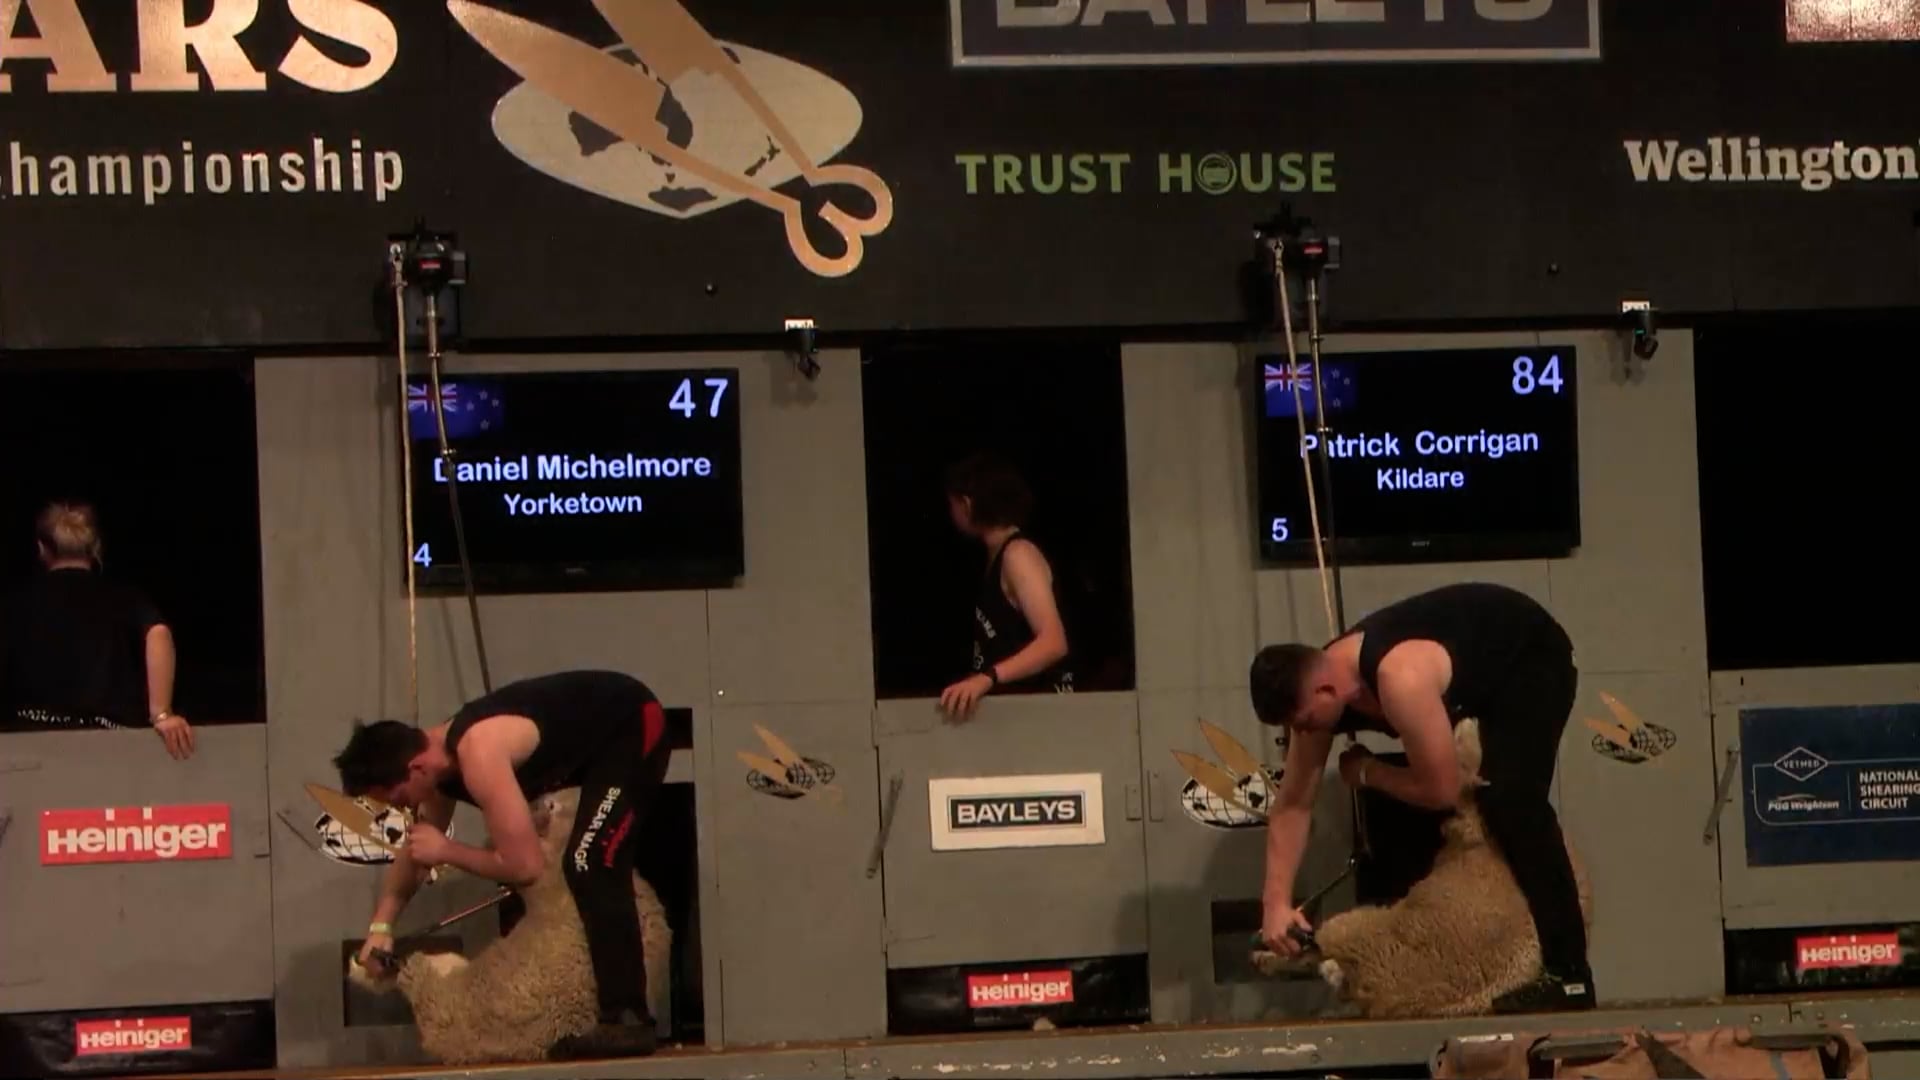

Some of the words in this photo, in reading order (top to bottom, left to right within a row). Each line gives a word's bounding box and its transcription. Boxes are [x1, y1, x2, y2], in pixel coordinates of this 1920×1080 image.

[0, 138, 403, 205] hampionship
[955, 153, 1131, 194] TRUST
[1158, 152, 1336, 194] HOUSE
[1511, 355, 1564, 395] 84
[668, 378, 728, 419] 47
[1300, 432, 1400, 458] Ptrick
[1415, 429, 1539, 459] Corrigan
[537, 454, 712, 480] Michelmore
[1376, 467, 1465, 490] Kildare
[503, 492, 643, 516] Yorketown
[1271, 517, 1289, 541] 5
[413, 543, 432, 567] 4
[1859, 770, 1920, 783] NATIONAL
[1860, 783, 1920, 797] SHEARING
[588, 786, 621, 830] SHEAR
[957, 800, 1076, 824] BAYLEYS
[1861, 797, 1908, 810] CIRCUIT
[47, 807, 226, 858] Heiniger
[1801, 935, 1896, 964] Heiniger
[972, 972, 1069, 1002] Heiniger
[80, 1018, 189, 1050] Heiniger
